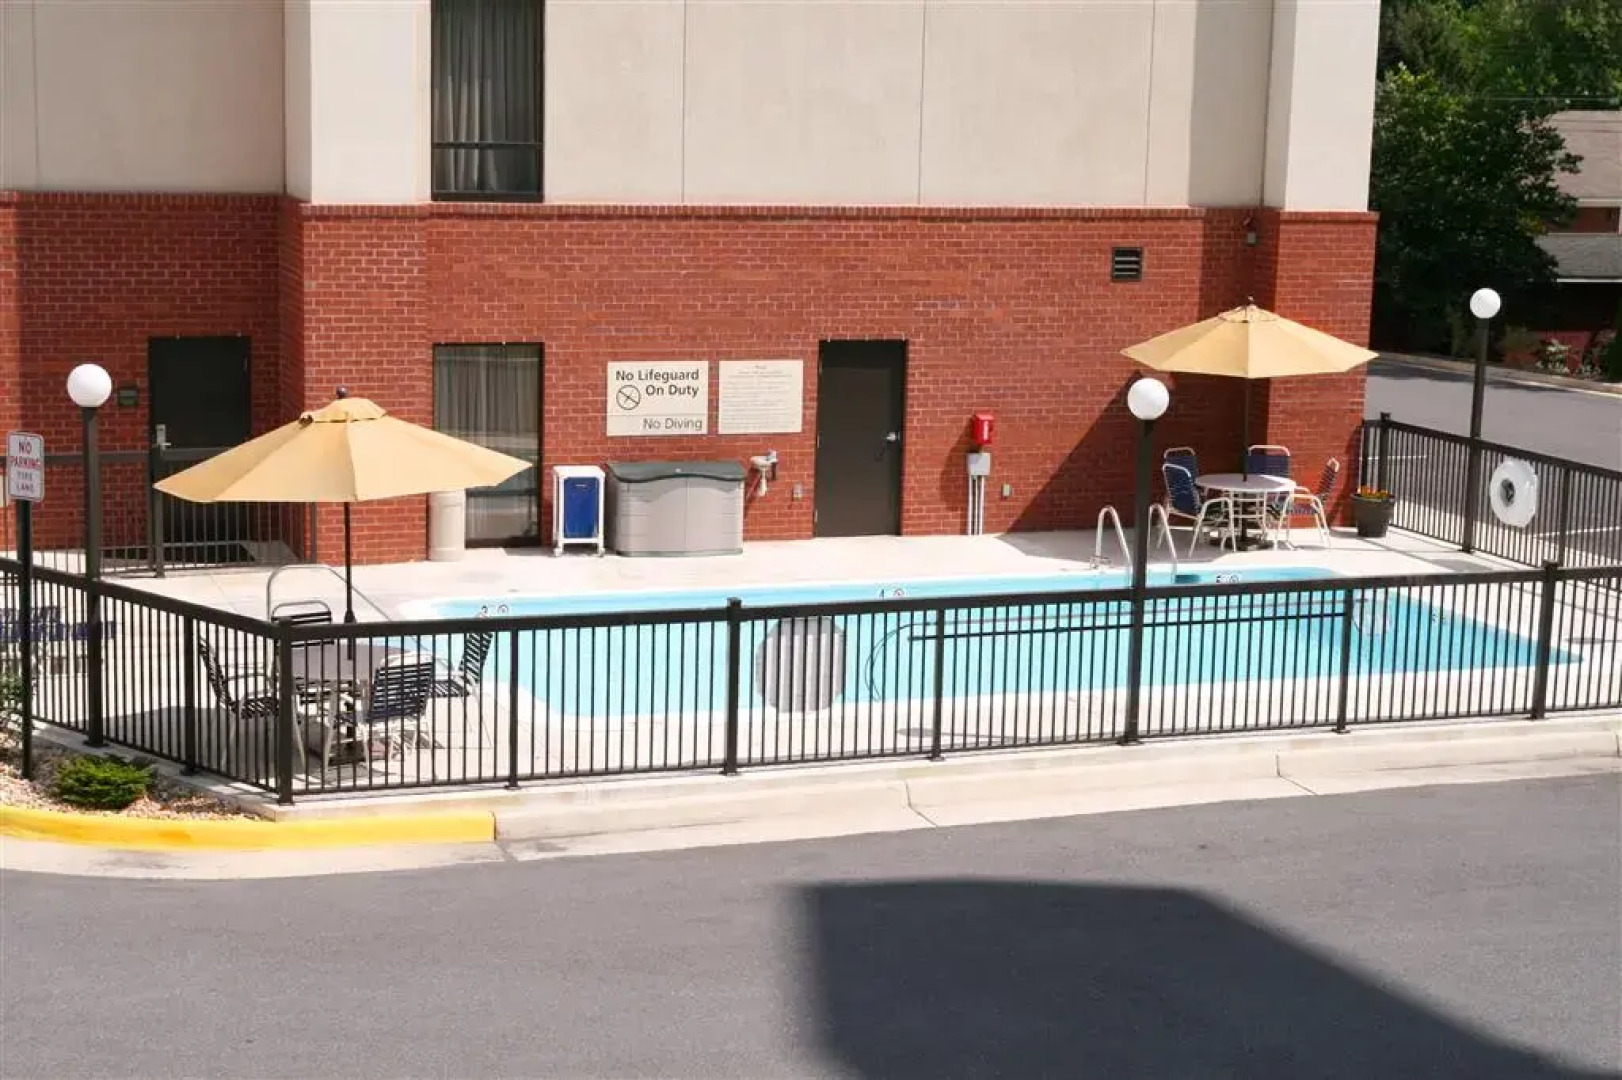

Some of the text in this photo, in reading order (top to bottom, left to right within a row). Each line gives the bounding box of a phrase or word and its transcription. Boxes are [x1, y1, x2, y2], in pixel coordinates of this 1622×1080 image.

[615, 369, 700, 383] No Lifeguard
[645, 385, 699, 398] On Duty
[643, 417, 703, 431] No Diving
[19, 441, 32, 454] NO
